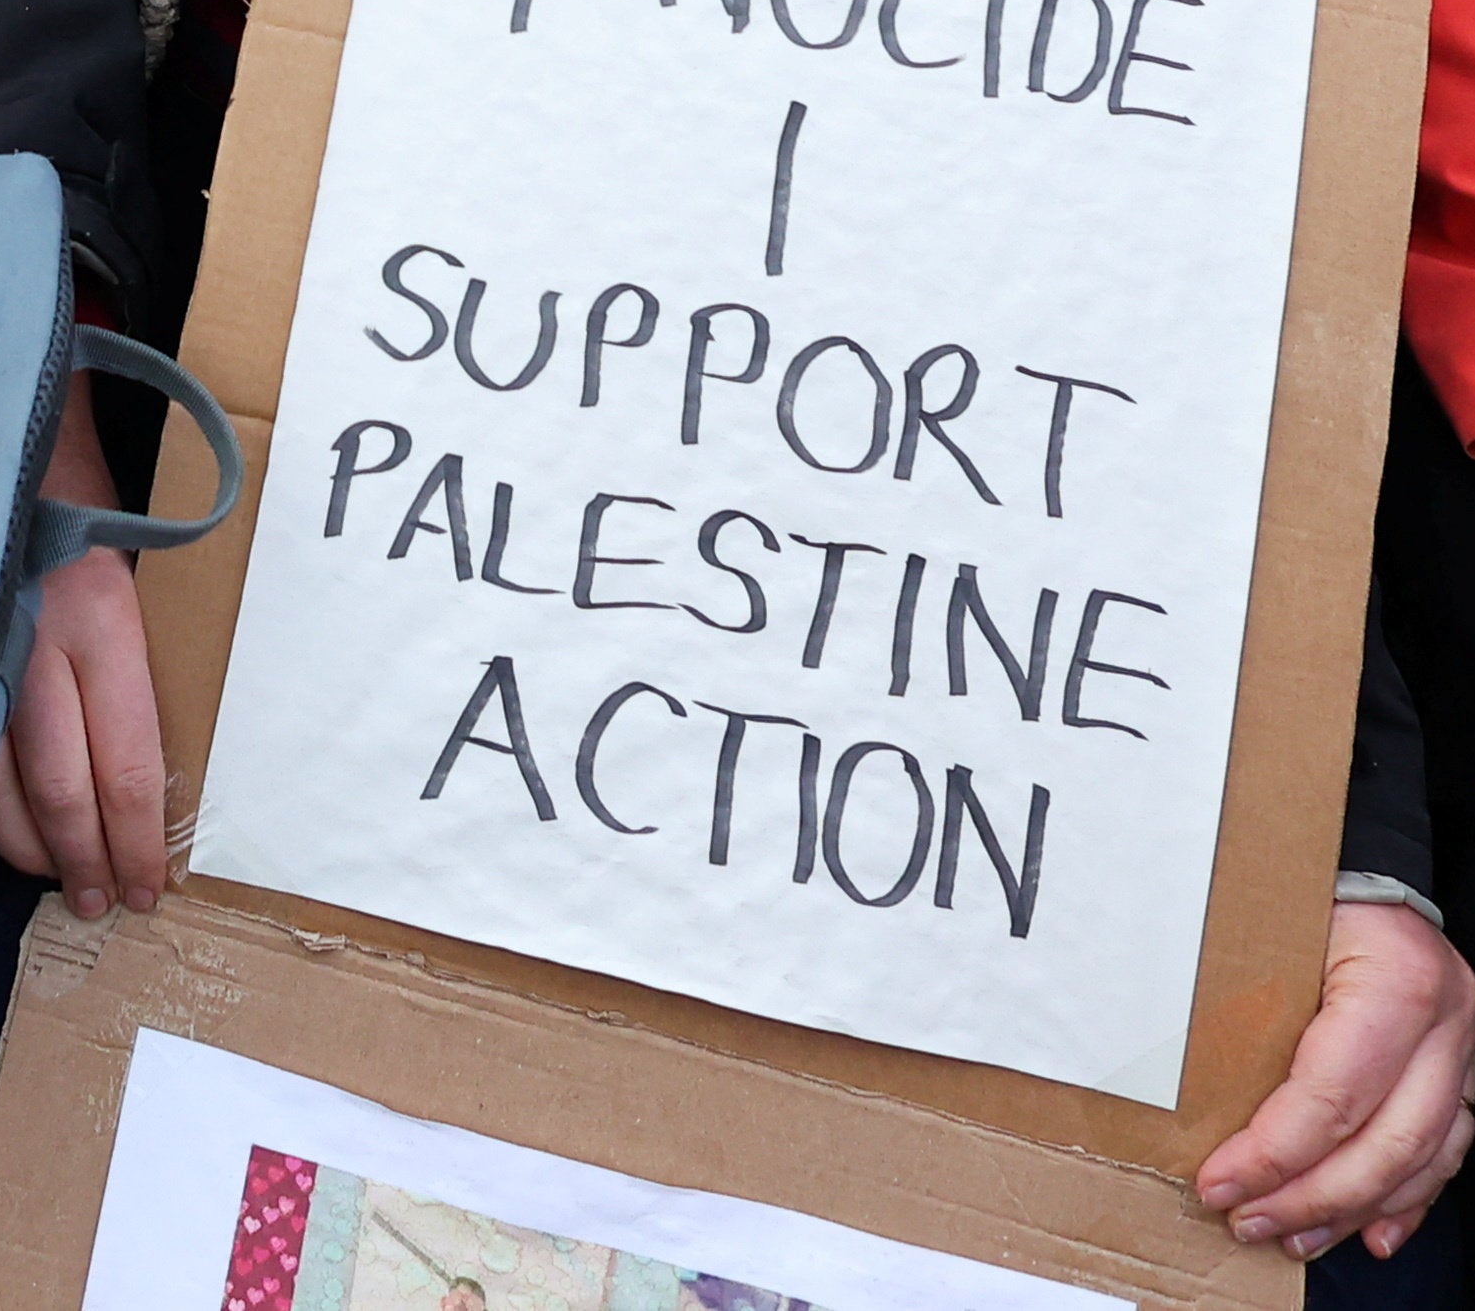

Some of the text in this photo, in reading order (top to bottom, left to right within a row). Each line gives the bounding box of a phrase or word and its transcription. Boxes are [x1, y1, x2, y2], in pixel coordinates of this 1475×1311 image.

[764, 100, 808, 278] I
[364, 243, 1138, 519] SUPPORT
[323, 419, 1174, 743] PALESTINE
[420, 655, 1052, 940] ACTION
